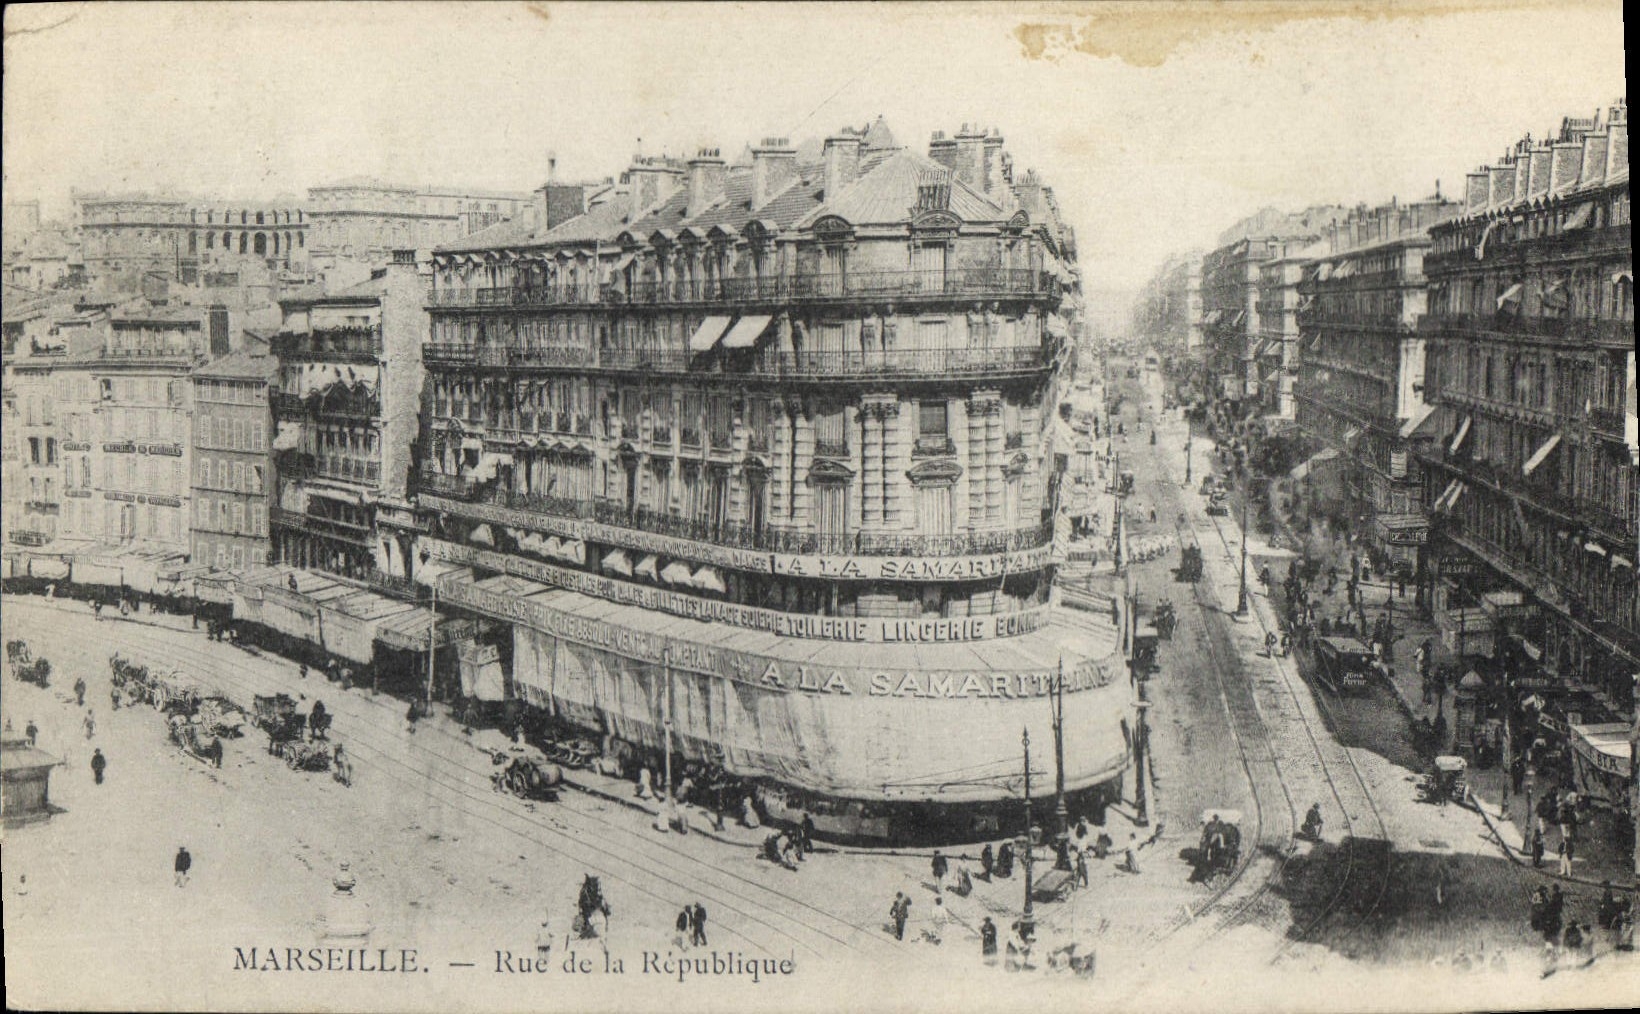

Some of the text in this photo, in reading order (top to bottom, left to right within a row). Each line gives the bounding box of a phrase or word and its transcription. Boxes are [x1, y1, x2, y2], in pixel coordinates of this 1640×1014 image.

[788, 558, 807, 575] A
[820, 559, 866, 578] LA
[787, 616, 867, 640] TOILERIE
[883, 621, 984, 641] LINGERIE
[664, 640, 718, 672] OMPTANT
[760, 661, 785, 688] A
[798, 666, 852, 695] LA
